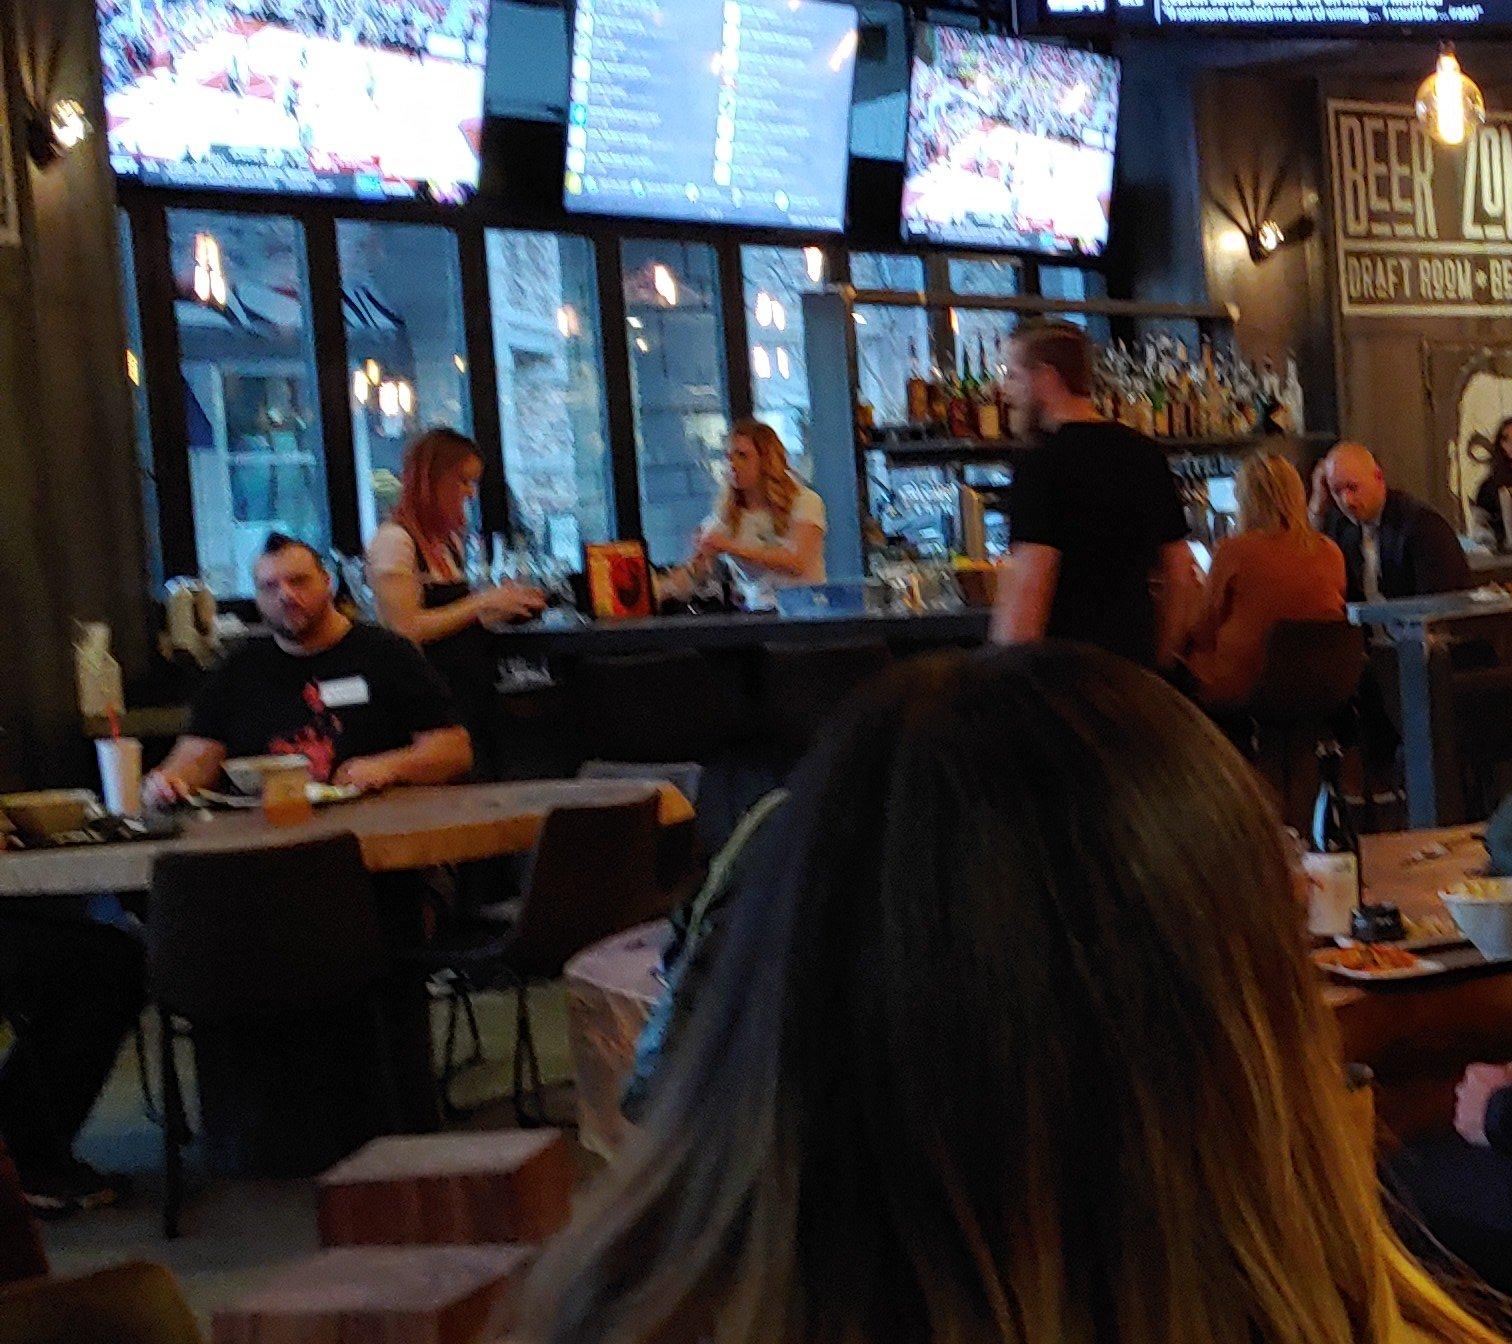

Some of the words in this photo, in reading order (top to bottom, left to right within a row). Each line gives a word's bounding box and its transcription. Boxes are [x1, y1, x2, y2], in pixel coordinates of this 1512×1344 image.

[1339, 115, 1439, 239] BEER
[1349, 257, 1412, 299] DRAFT
[1419, 259, 1473, 300] ROOM
